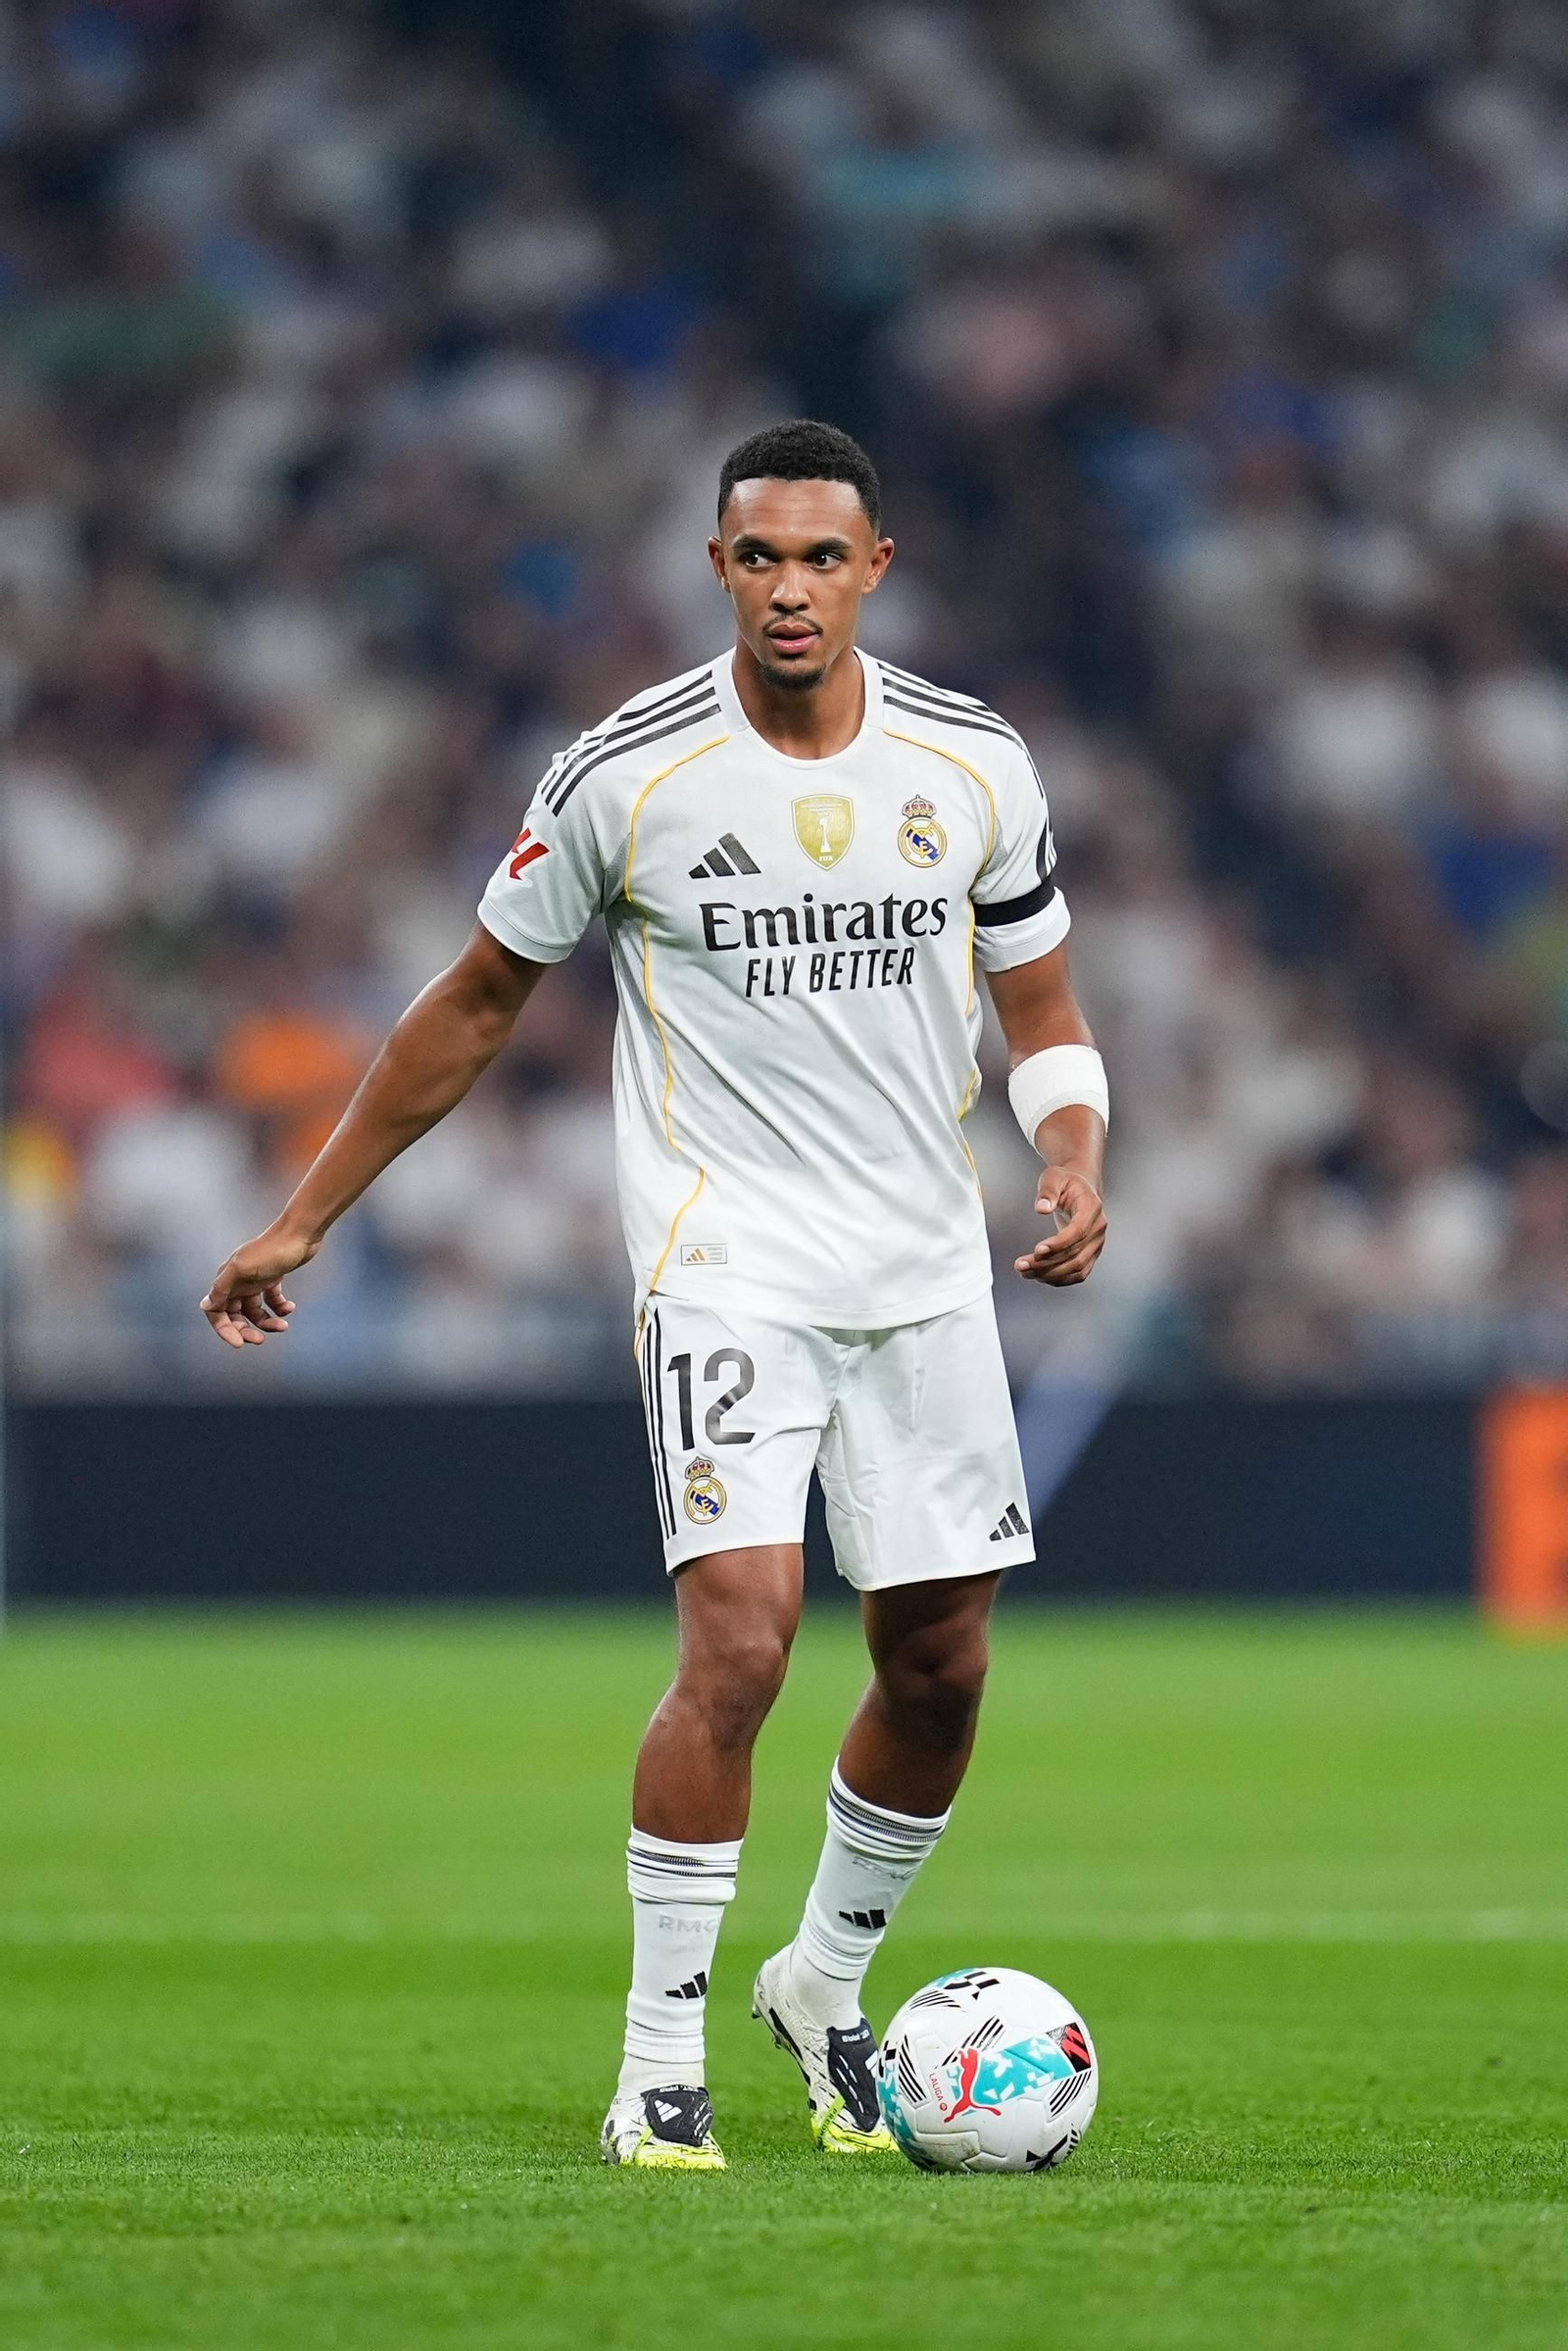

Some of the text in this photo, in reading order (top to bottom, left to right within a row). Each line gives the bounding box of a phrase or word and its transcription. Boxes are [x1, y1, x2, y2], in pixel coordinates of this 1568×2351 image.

[699, 893, 948, 952] Emirates
[746, 947, 914, 998] FLY BETTER
[666, 1347, 756, 1450] 12
[929, 2073, 944, 2102] LALIGA
